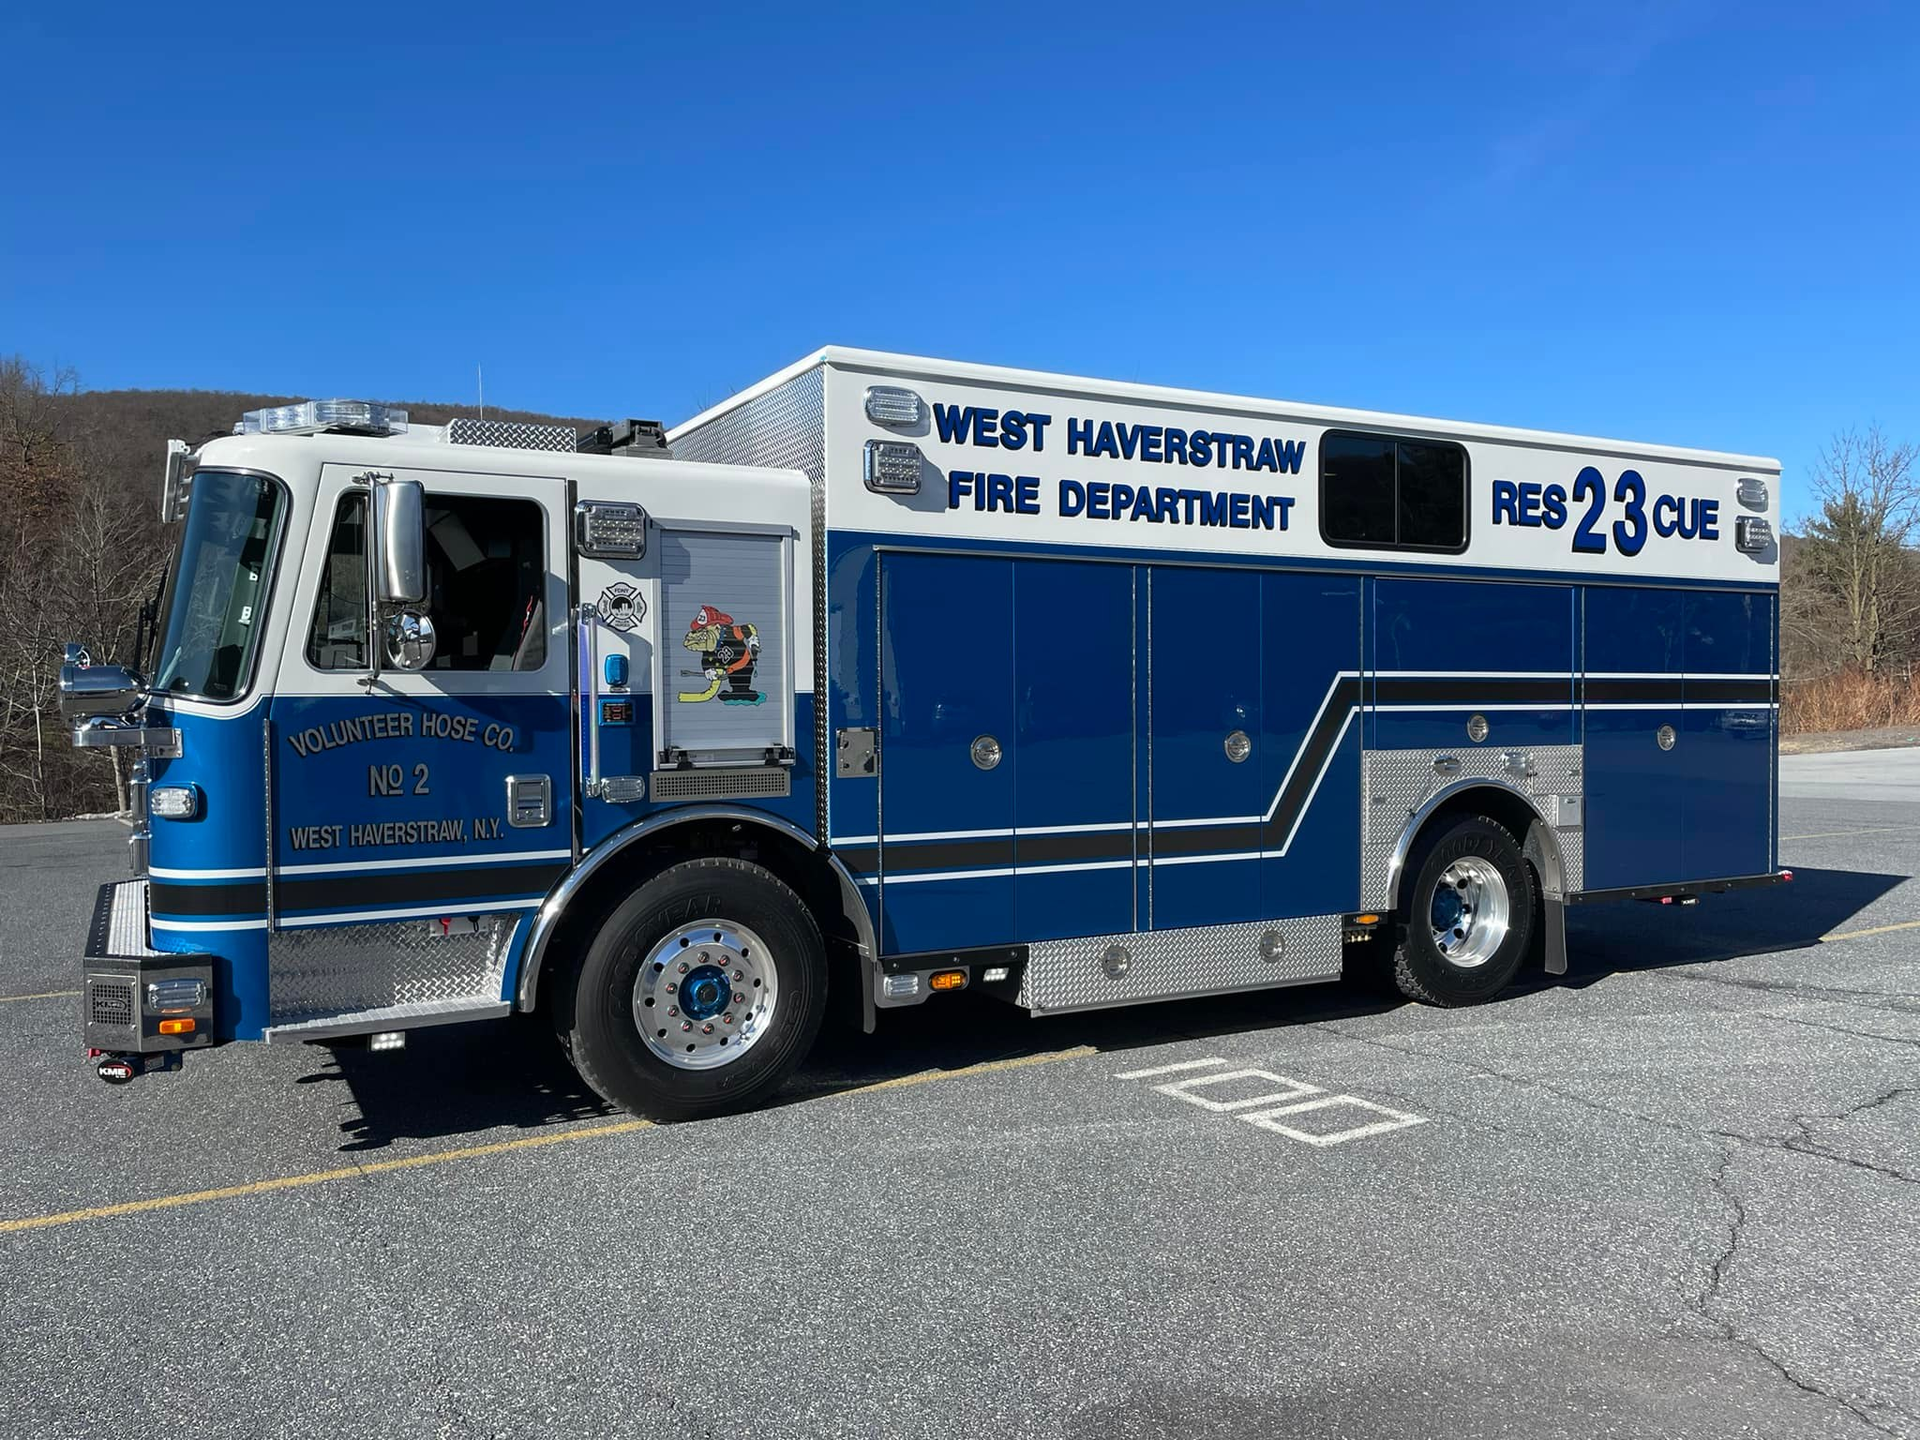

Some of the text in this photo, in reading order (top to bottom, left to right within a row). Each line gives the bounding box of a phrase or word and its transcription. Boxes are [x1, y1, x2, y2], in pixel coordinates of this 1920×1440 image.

[933, 403, 1306, 474] WEST HAVERSTRAW
[948, 470, 1295, 531] FIRE DEPARTMENT
[1572, 466, 1648, 557] 23
[288, 713, 514, 757] VOLUNTEER HOSE CO.
[413, 763, 430, 795] 2
[291, 817, 504, 850] WEST HAVERSTRAW, N.Y.
[98, 1067, 126, 1076] KME
